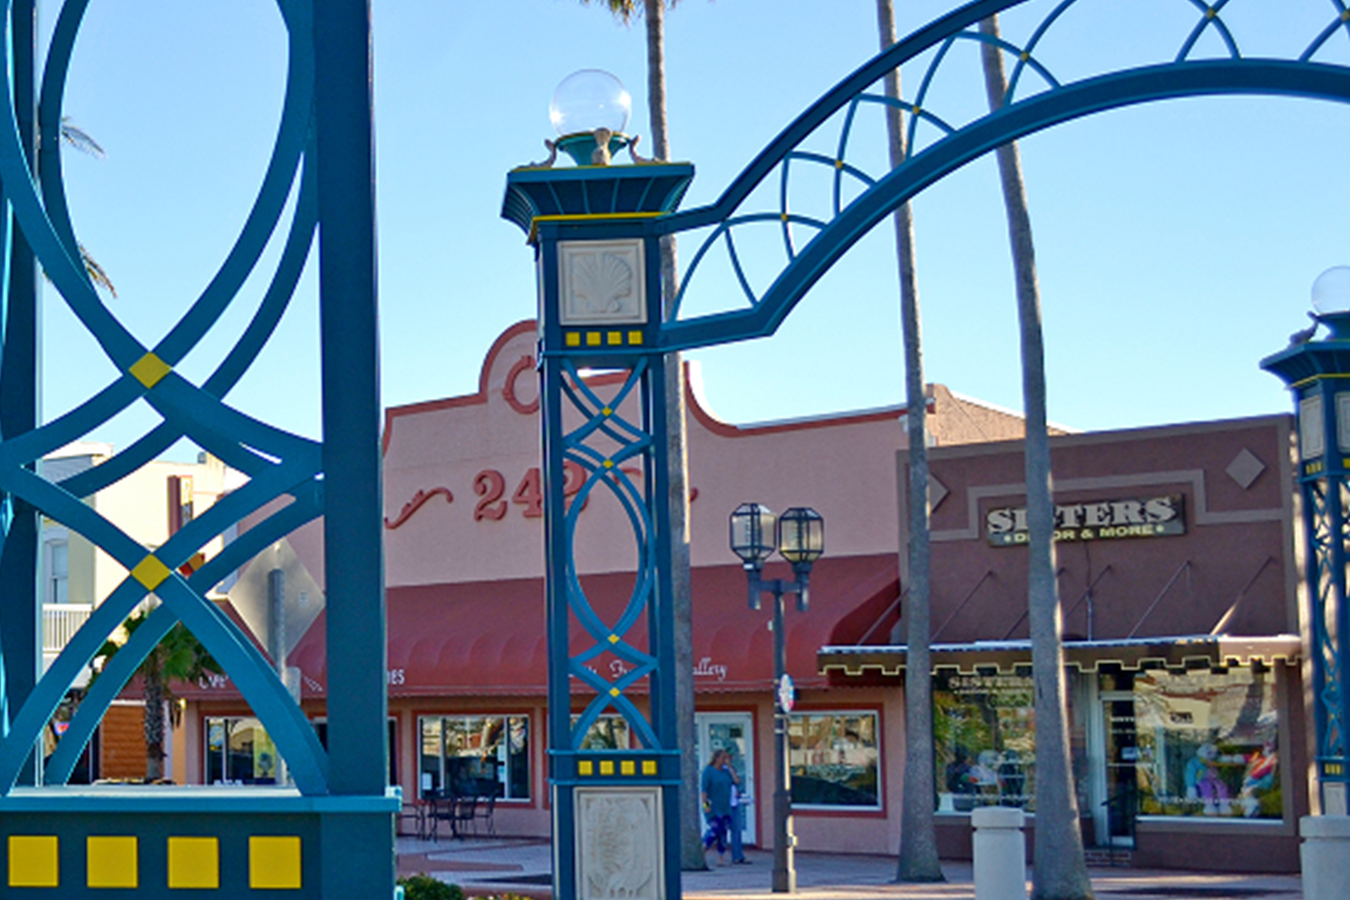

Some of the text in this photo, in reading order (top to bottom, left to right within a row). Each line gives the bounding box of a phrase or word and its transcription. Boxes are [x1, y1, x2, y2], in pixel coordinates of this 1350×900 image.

[987, 497, 1176, 533] SITERS
[1014, 523, 1153, 542] DOR & MORE
